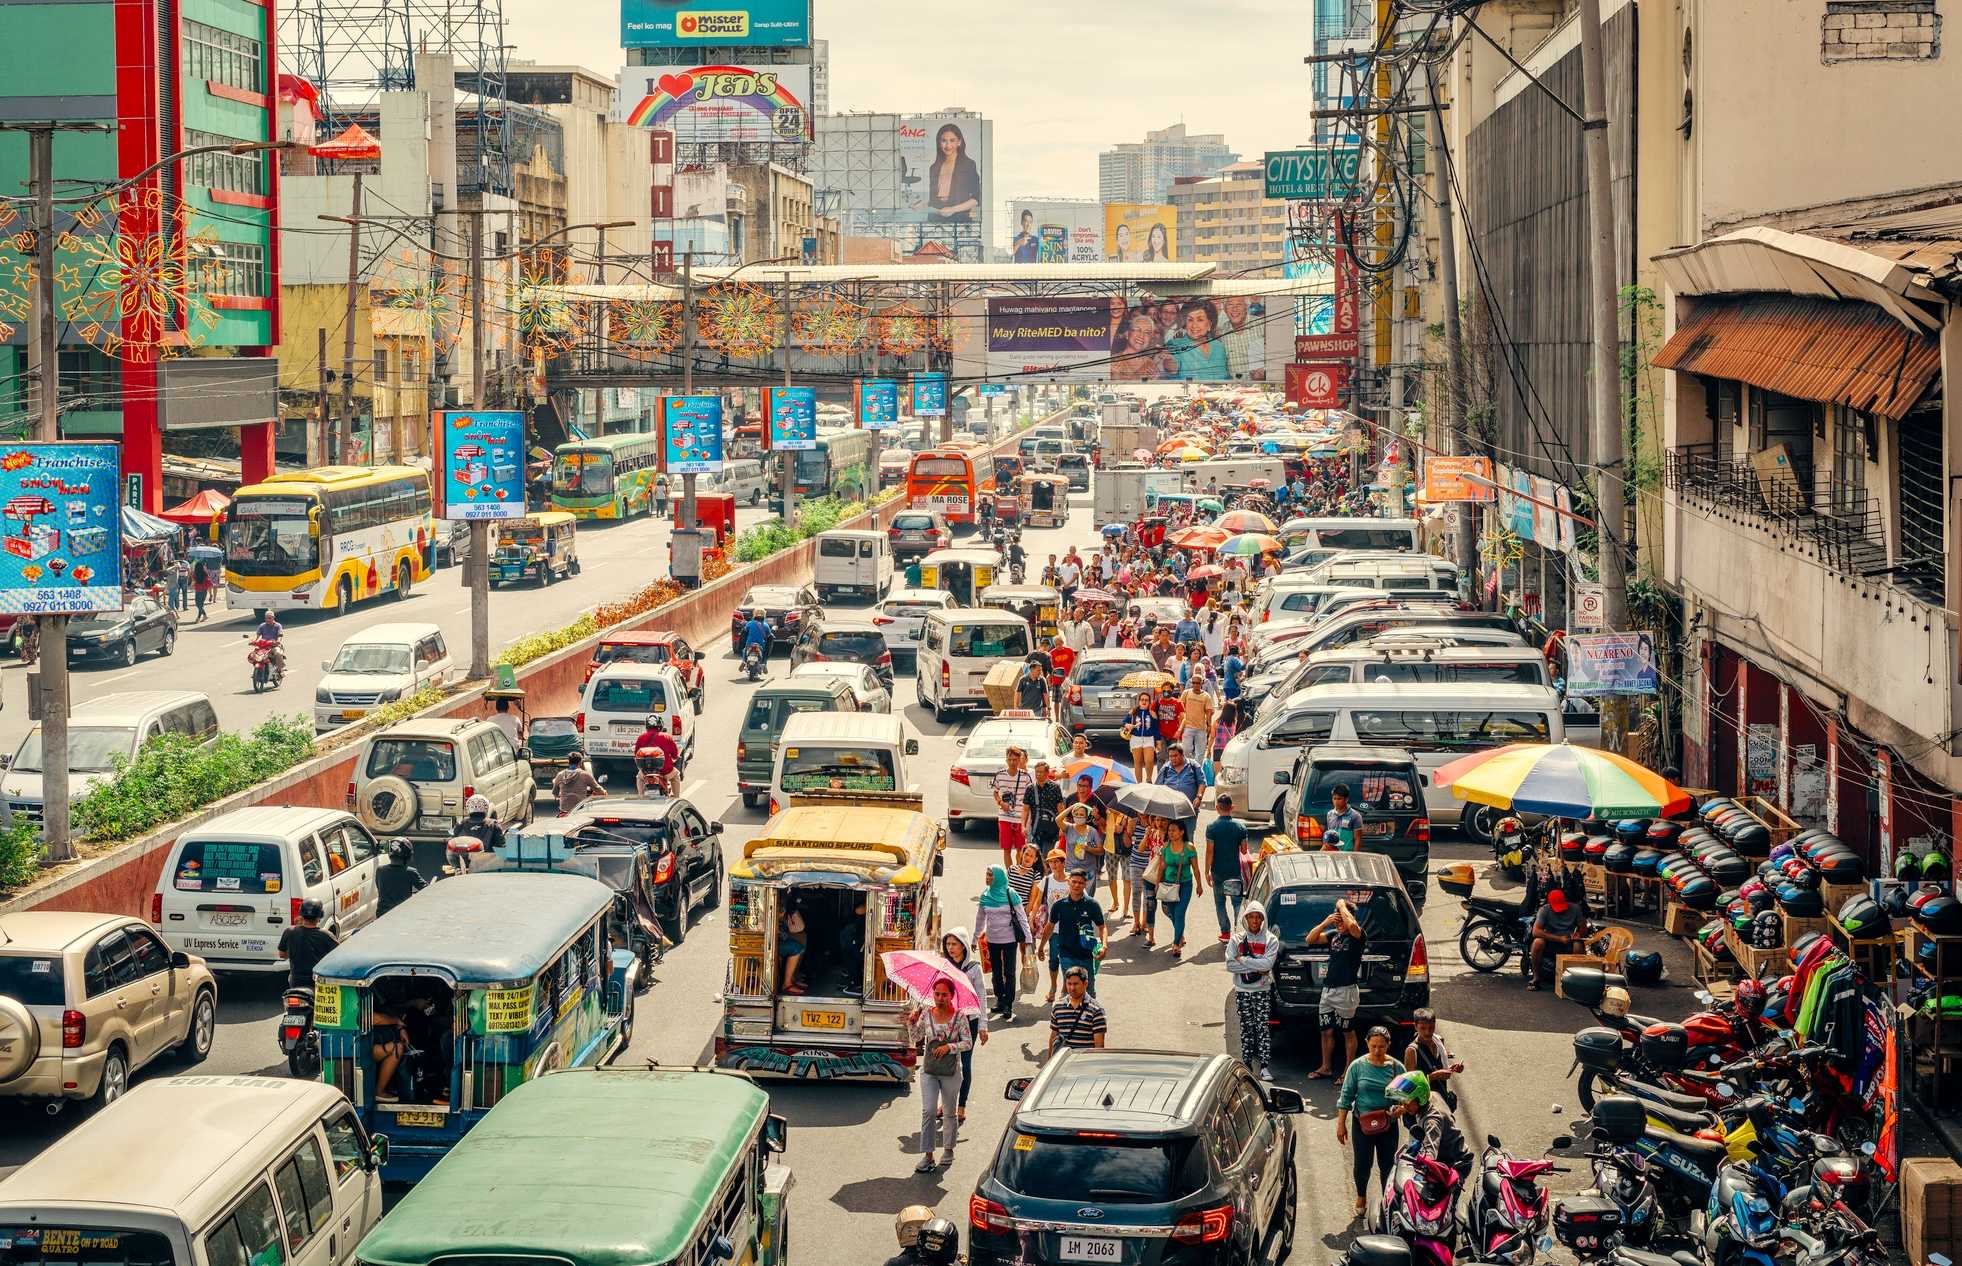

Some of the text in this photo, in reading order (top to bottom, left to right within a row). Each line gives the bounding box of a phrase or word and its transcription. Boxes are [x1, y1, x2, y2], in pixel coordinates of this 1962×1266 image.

[698, 16, 744, 25] Mister
[655, 23, 672, 31] mag
[698, 25, 744, 33] Donut
[645, 72, 777, 101] I JED'S
[778, 114, 800, 129] 24
[1269, 184, 1296, 194] HOTEL
[1296, 184, 1303, 193] &
[1076, 246, 1094, 254] 100%
[1071, 254, 1099, 262] ACRYLIC
[999, 306, 1023, 314] Huwag
[992, 327, 1106, 340] May RiteMED ba nito?
[1297, 339, 1358, 352] PAWNSHOP
[36, 457, 104, 468] Franchise
[931, 496, 945, 504] MA
[946, 496, 968, 504] ROSE
[37, 589, 82, 600] 563 1408
[23, 600, 93, 612] 0927 011 8000
[1587, 648, 1633, 660] NAZARENO
[775, 840, 874, 850] SAN ANTONIO SPURS
[183, 938, 240, 951] UV Express Service
[489, 1012, 502, 1020] TEXT
[826, 1014, 841, 1024] 122
[42, 1230, 80, 1245] BENTE
[100, 1239, 119, 1249] ROAD
[41, 1245, 80, 1254] QUATRO
[1087, 1242, 1115, 1256] 2063
